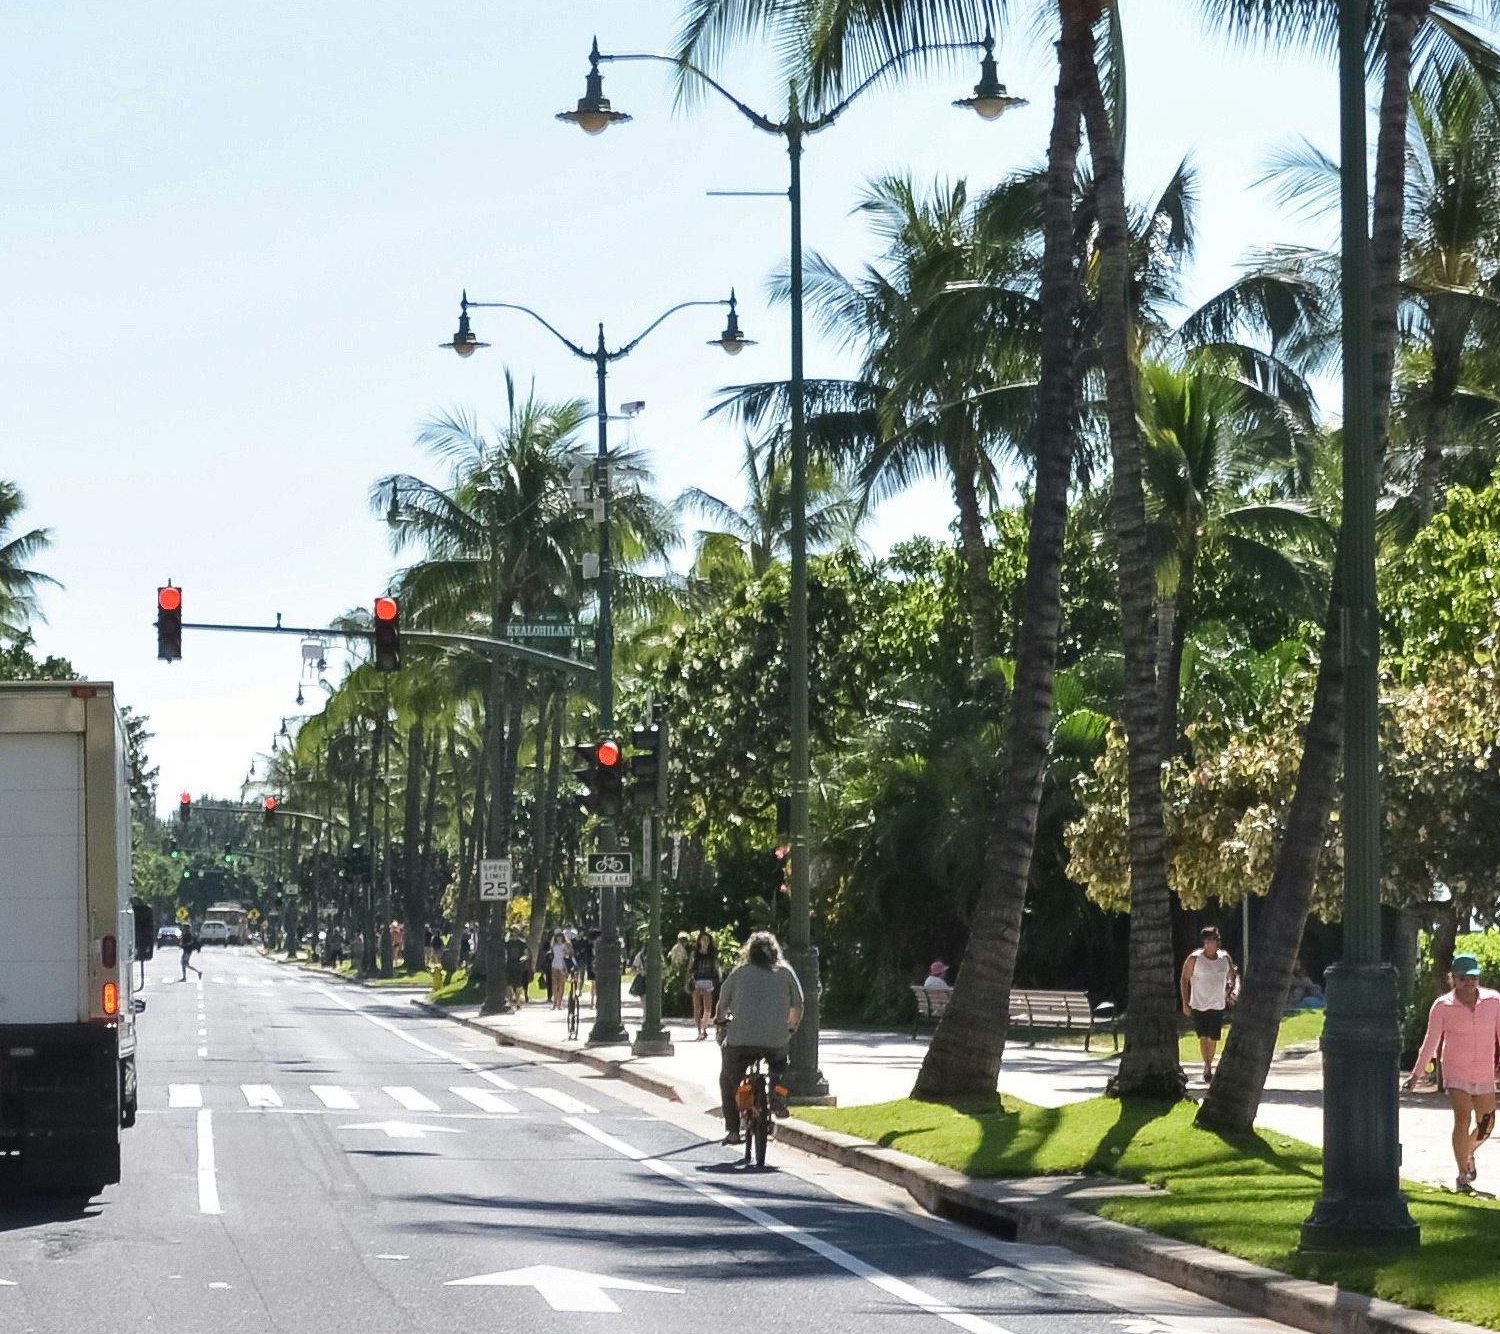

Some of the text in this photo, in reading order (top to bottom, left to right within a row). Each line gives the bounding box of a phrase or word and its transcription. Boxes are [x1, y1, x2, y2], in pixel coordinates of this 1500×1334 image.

[506, 625, 575, 637] KEALOHILANI
[483, 864, 509, 872] SPEED
[484, 872, 506, 880] LIMIT
[589, 874, 628, 884] BIKE LANE
[483, 881, 508, 896] 25
